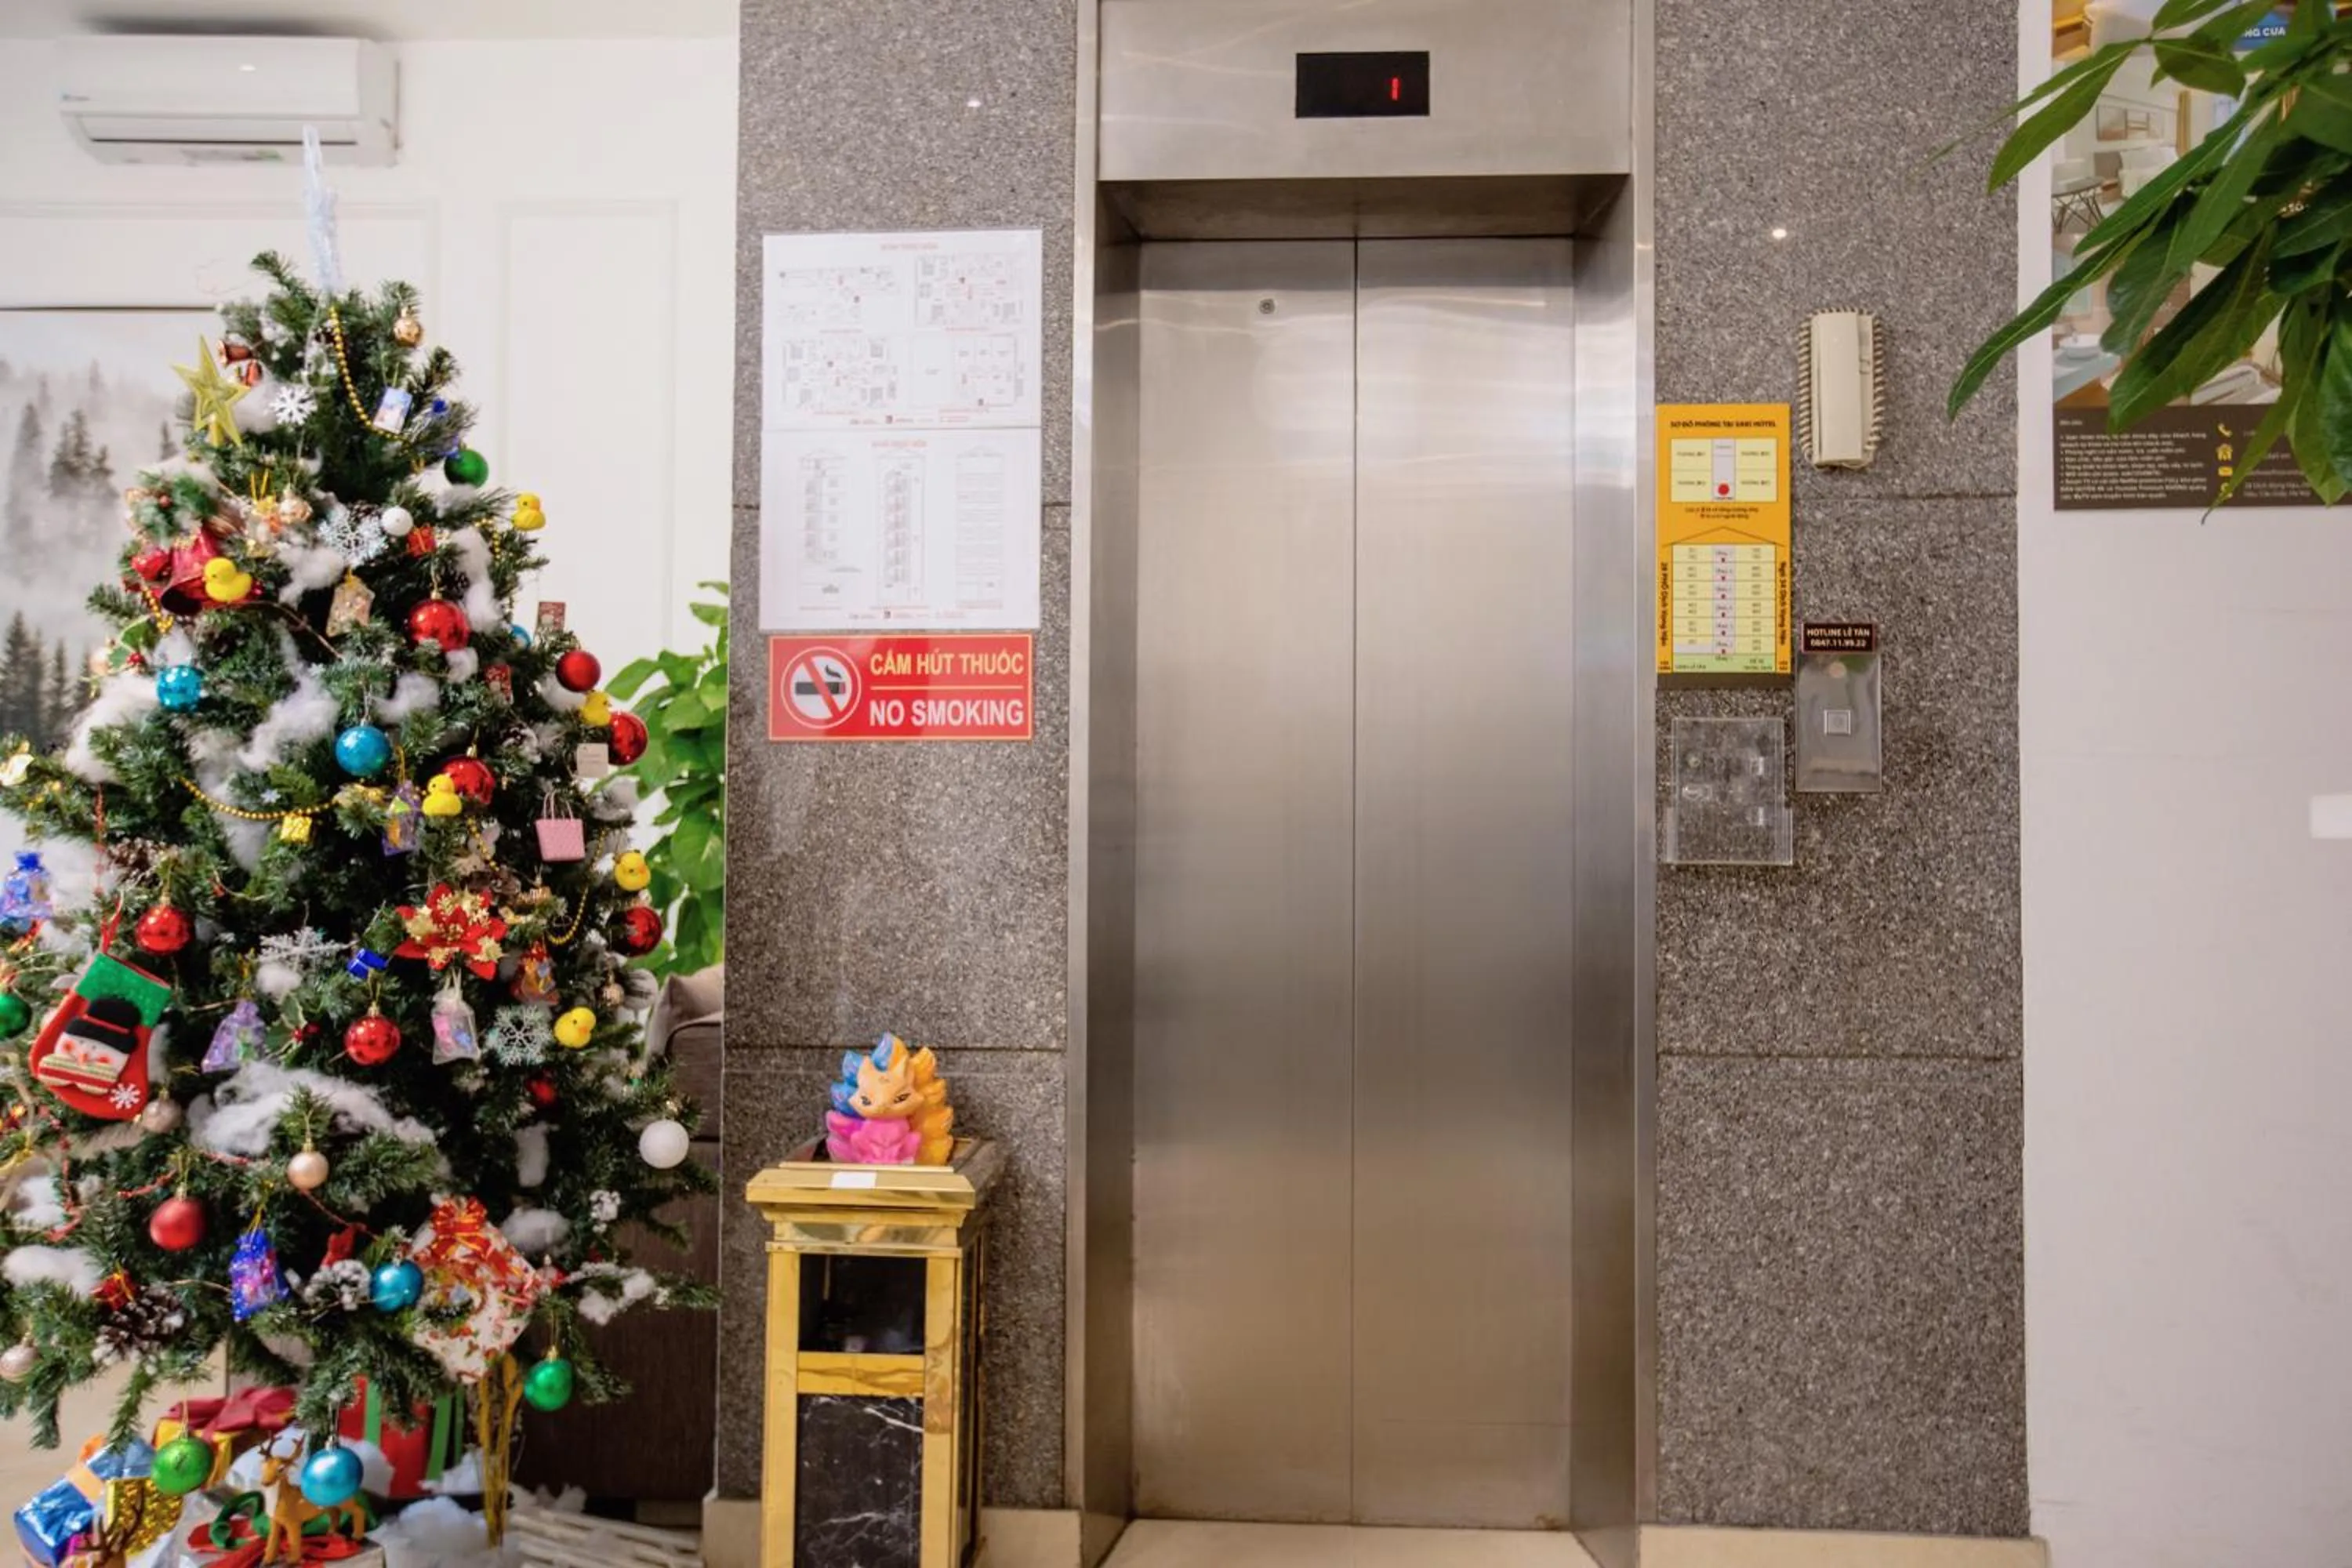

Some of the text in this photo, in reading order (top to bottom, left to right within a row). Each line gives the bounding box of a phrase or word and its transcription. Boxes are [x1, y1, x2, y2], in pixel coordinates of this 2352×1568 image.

[1391, 77, 1400, 101] 1
[1806, 628, 1842, 637] HOTLINE
[916, 648, 955, 675] HÚT
[869, 699, 1025, 726] NO SMOKING
